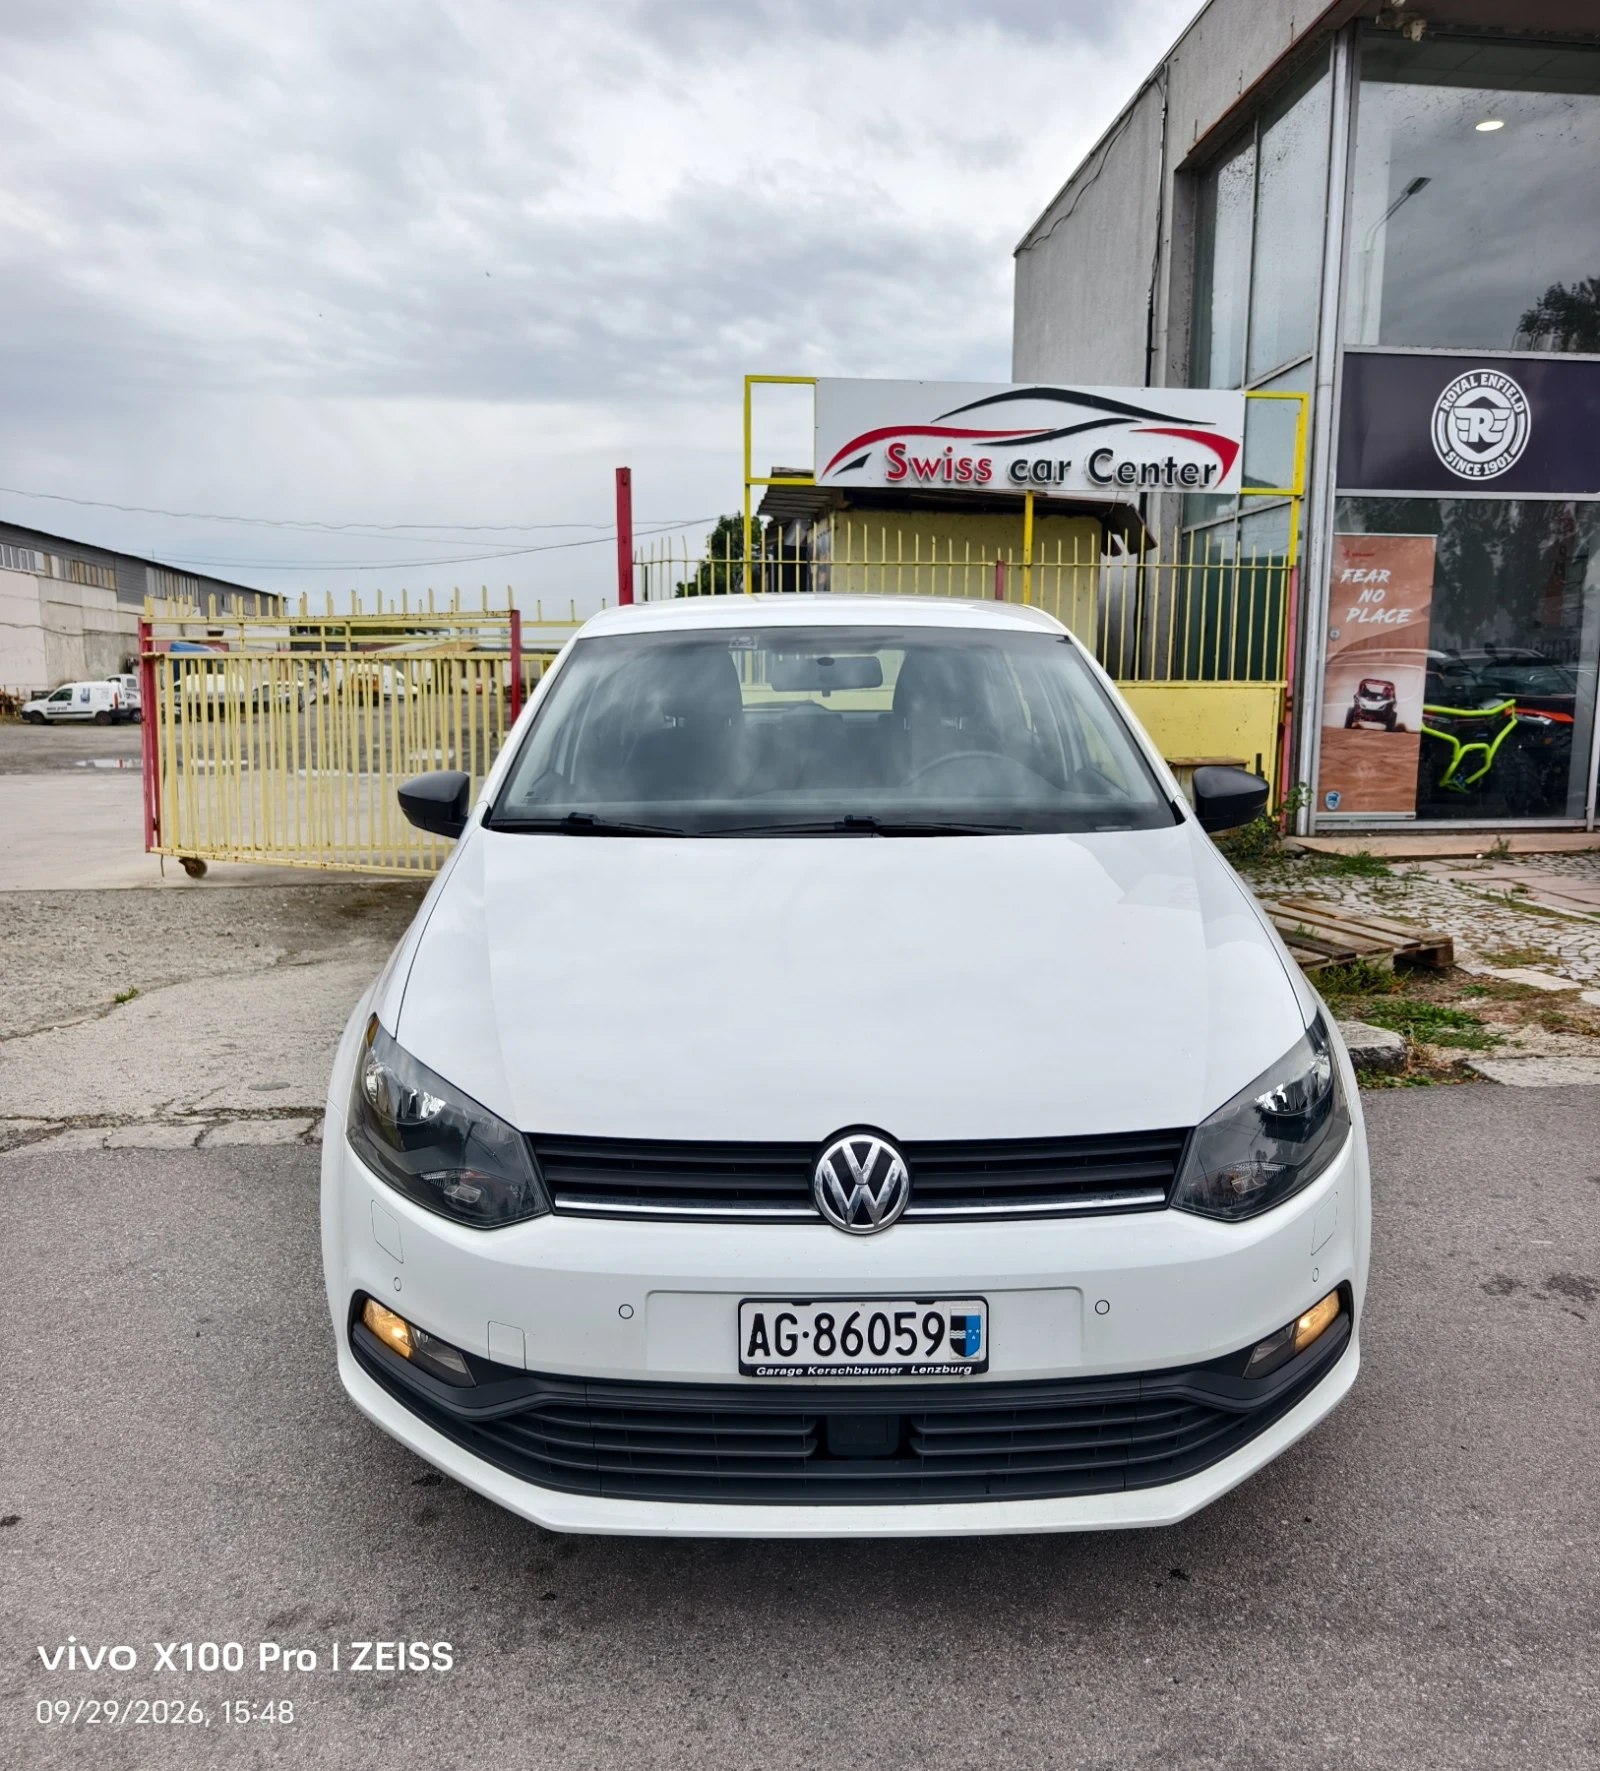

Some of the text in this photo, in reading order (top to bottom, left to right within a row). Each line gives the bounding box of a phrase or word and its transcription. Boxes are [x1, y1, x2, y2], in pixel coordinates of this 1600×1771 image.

[1440, 374, 1525, 413] ROYAL ENFIELD
[885, 442, 1218, 487] Swiss car Center
[1445, 451, 1513, 475] SINCE 1901
[1340, 569, 1391, 583] FEAR
[1358, 589, 1385, 603] NO
[1345, 607, 1412, 623] PLACE
[756, 1366, 972, 1376] Garage Kerschbaumer Lenzburg
